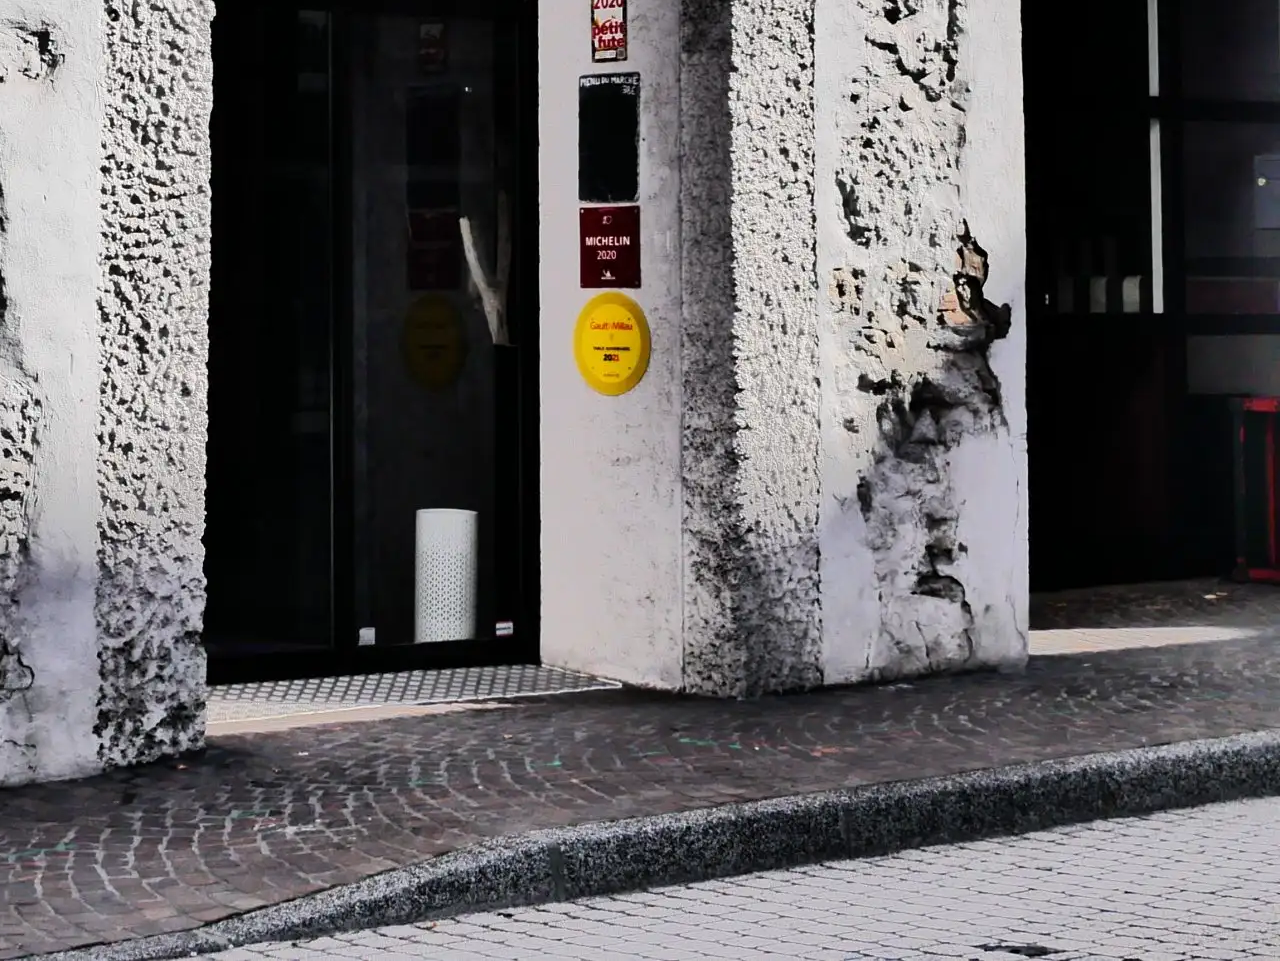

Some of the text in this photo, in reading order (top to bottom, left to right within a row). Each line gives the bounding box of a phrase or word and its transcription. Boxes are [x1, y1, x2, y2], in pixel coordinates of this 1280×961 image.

[592, 22, 626, 39] petit
[585, 235, 631, 246] MICHELIN
[596, 250, 617, 260] 2020
